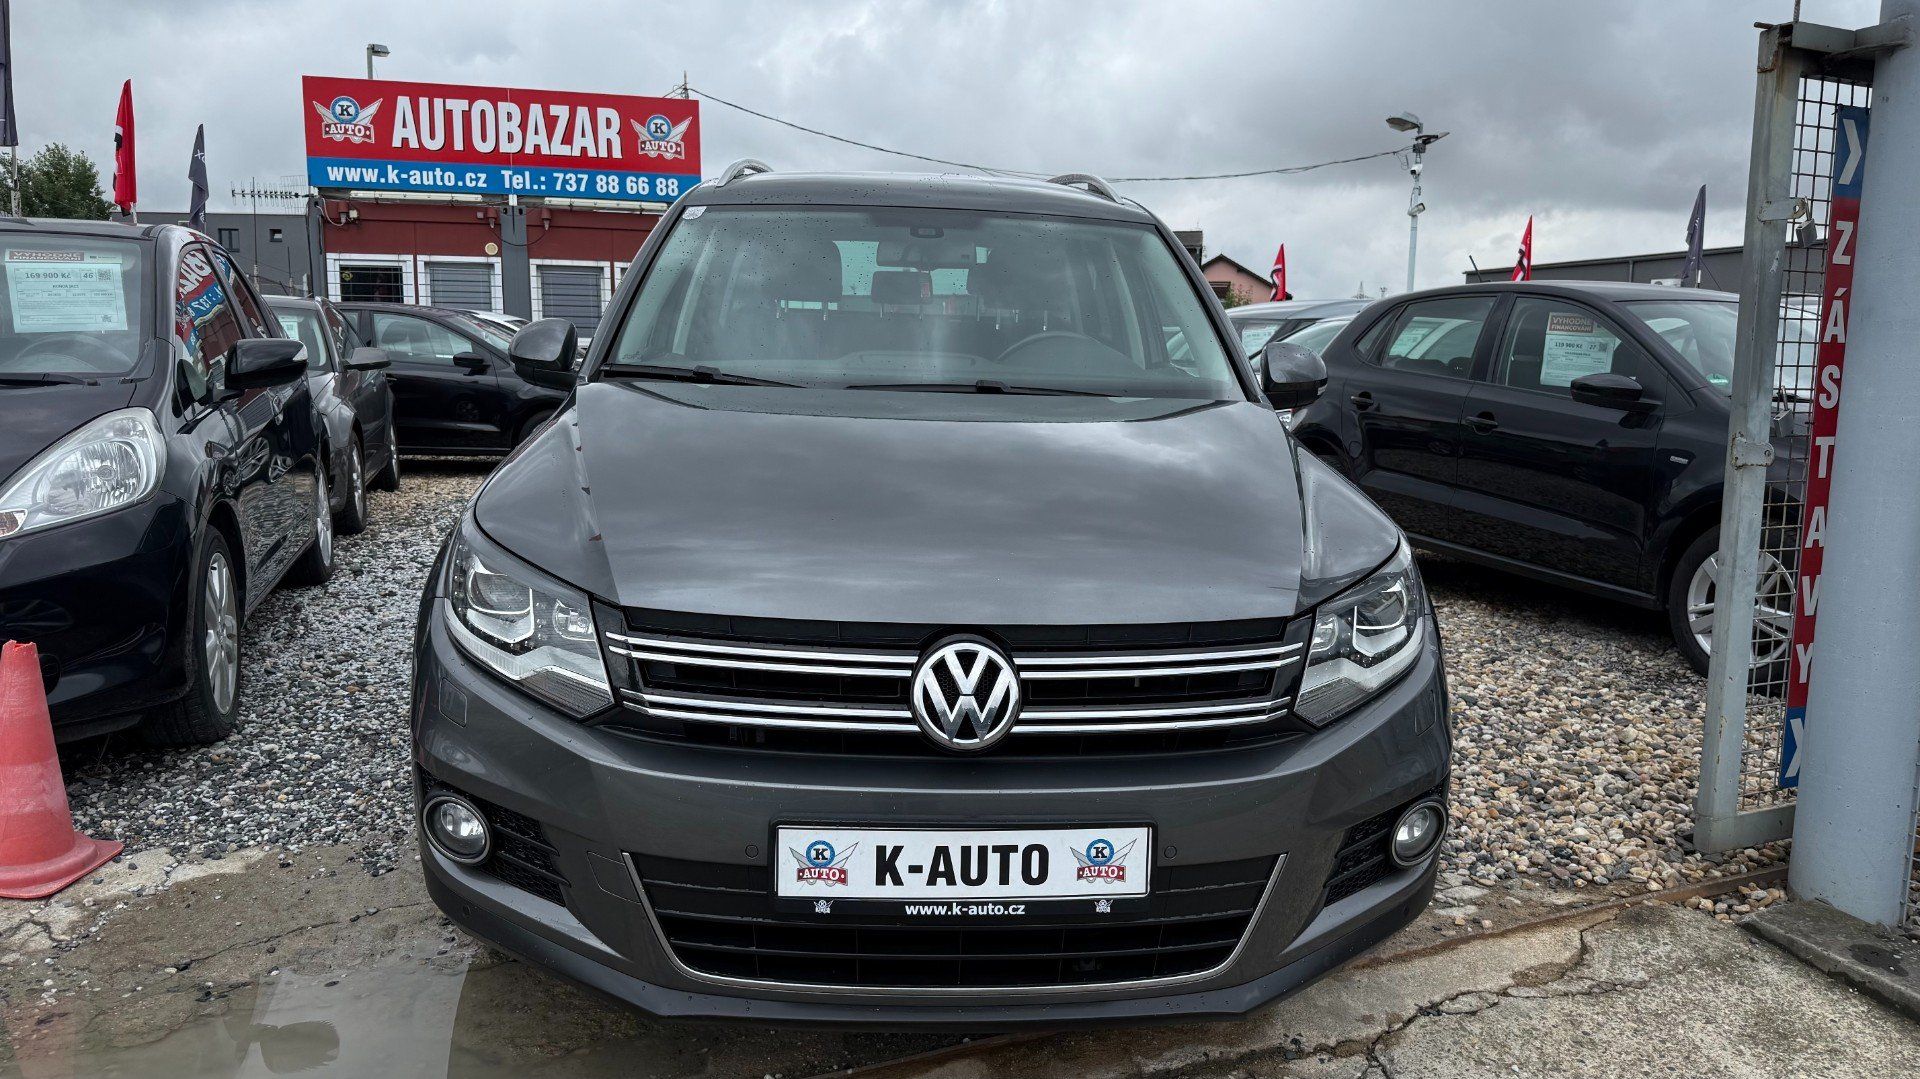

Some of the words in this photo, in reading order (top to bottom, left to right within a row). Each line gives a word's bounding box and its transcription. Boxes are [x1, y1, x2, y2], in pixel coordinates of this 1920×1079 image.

[338, 104, 354, 117] K
[329, 123, 366, 138] AUTO
[391, 95, 623, 159] AUTOBAZAR
[653, 121, 666, 135] K
[644, 140, 677, 155] AUTO
[326, 164, 488, 188] www.k-auto.cz
[501, 169, 546, 191] Tel.:
[553, 172, 589, 193] 737
[596, 174, 620, 195] 88
[626, 176, 649, 195] 66
[655, 177, 680, 197] 88
[813, 847, 829, 860] K
[1093, 846, 1108, 859] K
[875, 843, 1050, 887] K-AUTO
[1082, 866, 1118, 879] AUTO
[802, 868, 839, 881] AUTO
[904, 901, 1026, 917] www.k-auto.cz
